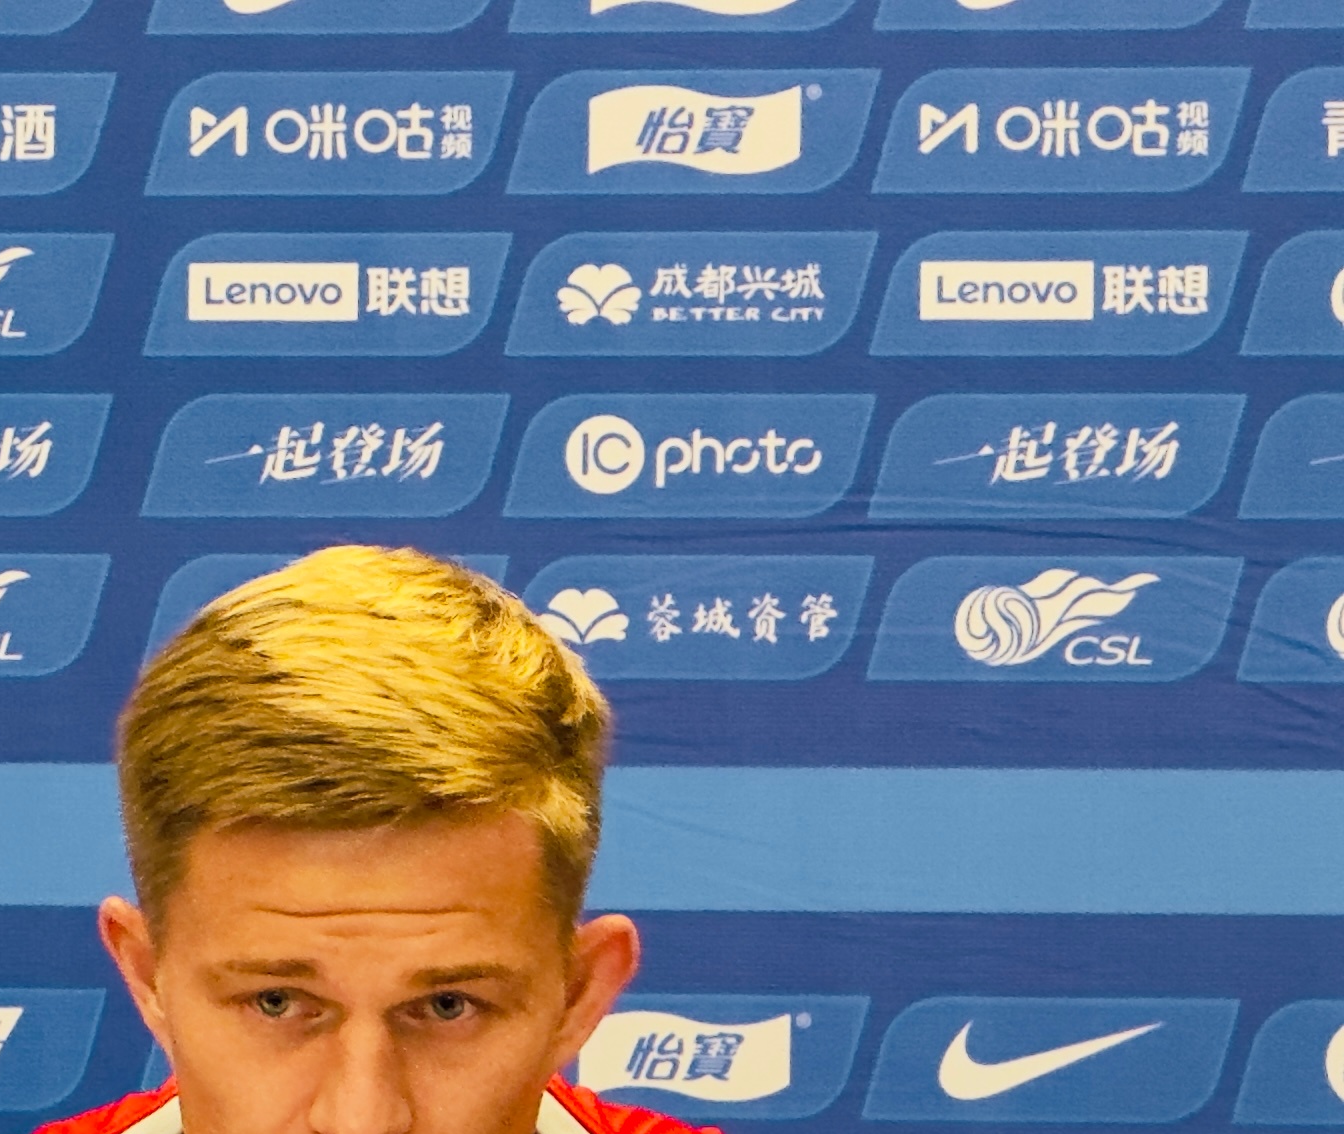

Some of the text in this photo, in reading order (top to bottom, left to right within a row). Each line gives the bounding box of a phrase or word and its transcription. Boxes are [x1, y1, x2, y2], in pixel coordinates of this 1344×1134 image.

[635, 104, 755, 155] 怡寶
[205, 266, 470, 317] Lenovo 联想
[649, 263, 825, 302] 成都兴城
[936, 264, 1209, 315] Lenovo 联想
[652, 306, 824, 322] BETTER CITY
[205, 421, 444, 484] 一起登场
[935, 421, 1180, 483] 一起登场
[647, 593, 838, 644] 蓉城资管
[1064, 635, 1152, 666] CSL
[626, 1031, 745, 1081] 怡寶
